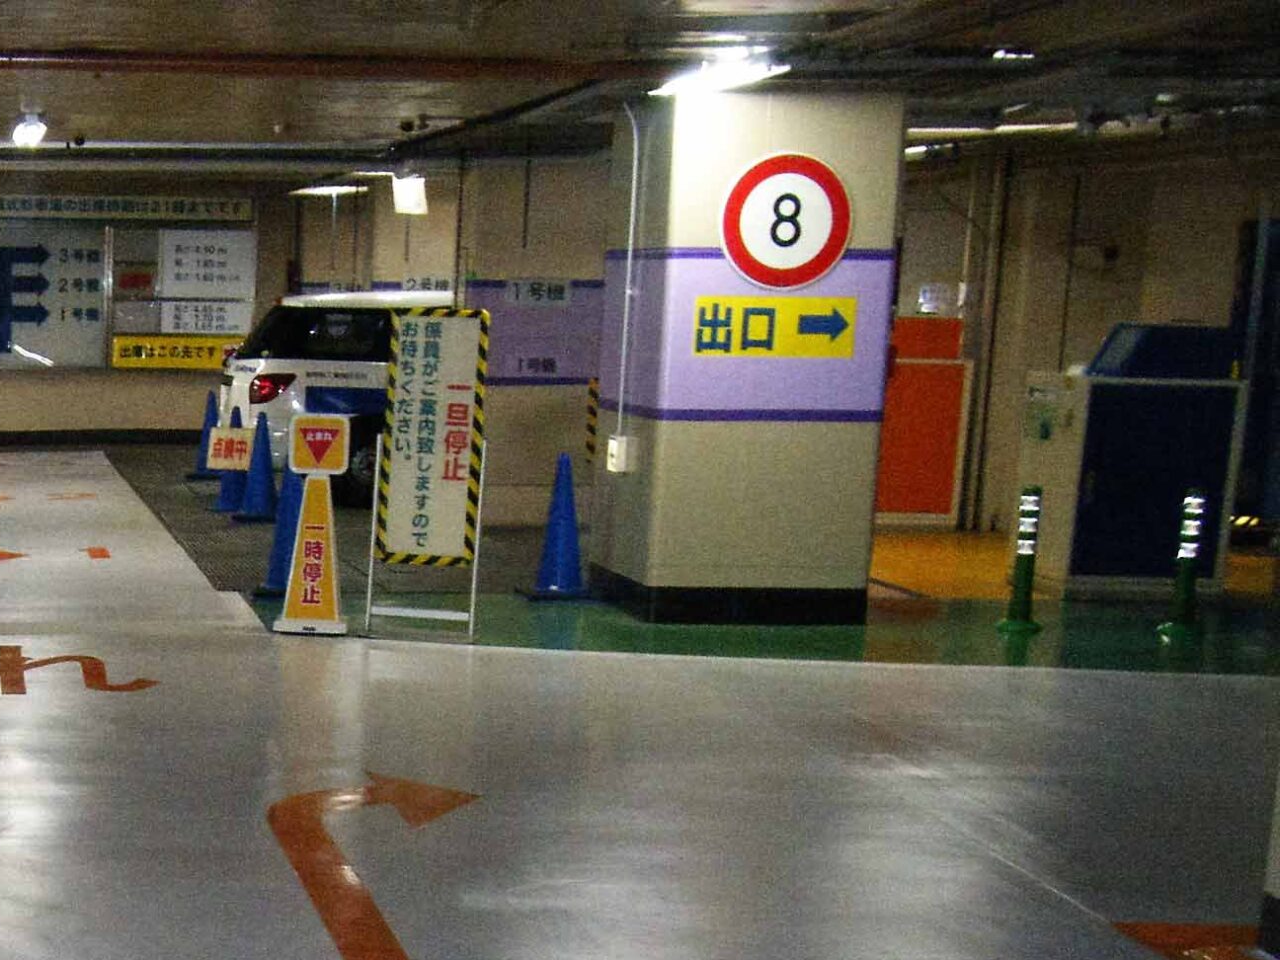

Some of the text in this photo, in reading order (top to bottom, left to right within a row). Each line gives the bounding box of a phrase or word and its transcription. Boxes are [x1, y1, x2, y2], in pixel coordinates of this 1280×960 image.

[770, 192, 801, 247] 8
[695, 303, 776, 353] 出口
[211, 437, 248, 461] 点検中
[305, 432, 333, 441] 止まれ
[411, 321, 443, 547] 係員がご案内致しますので
[441, 383, 472, 481] 一旦停止
[302, 524, 326, 604] 一時停止
